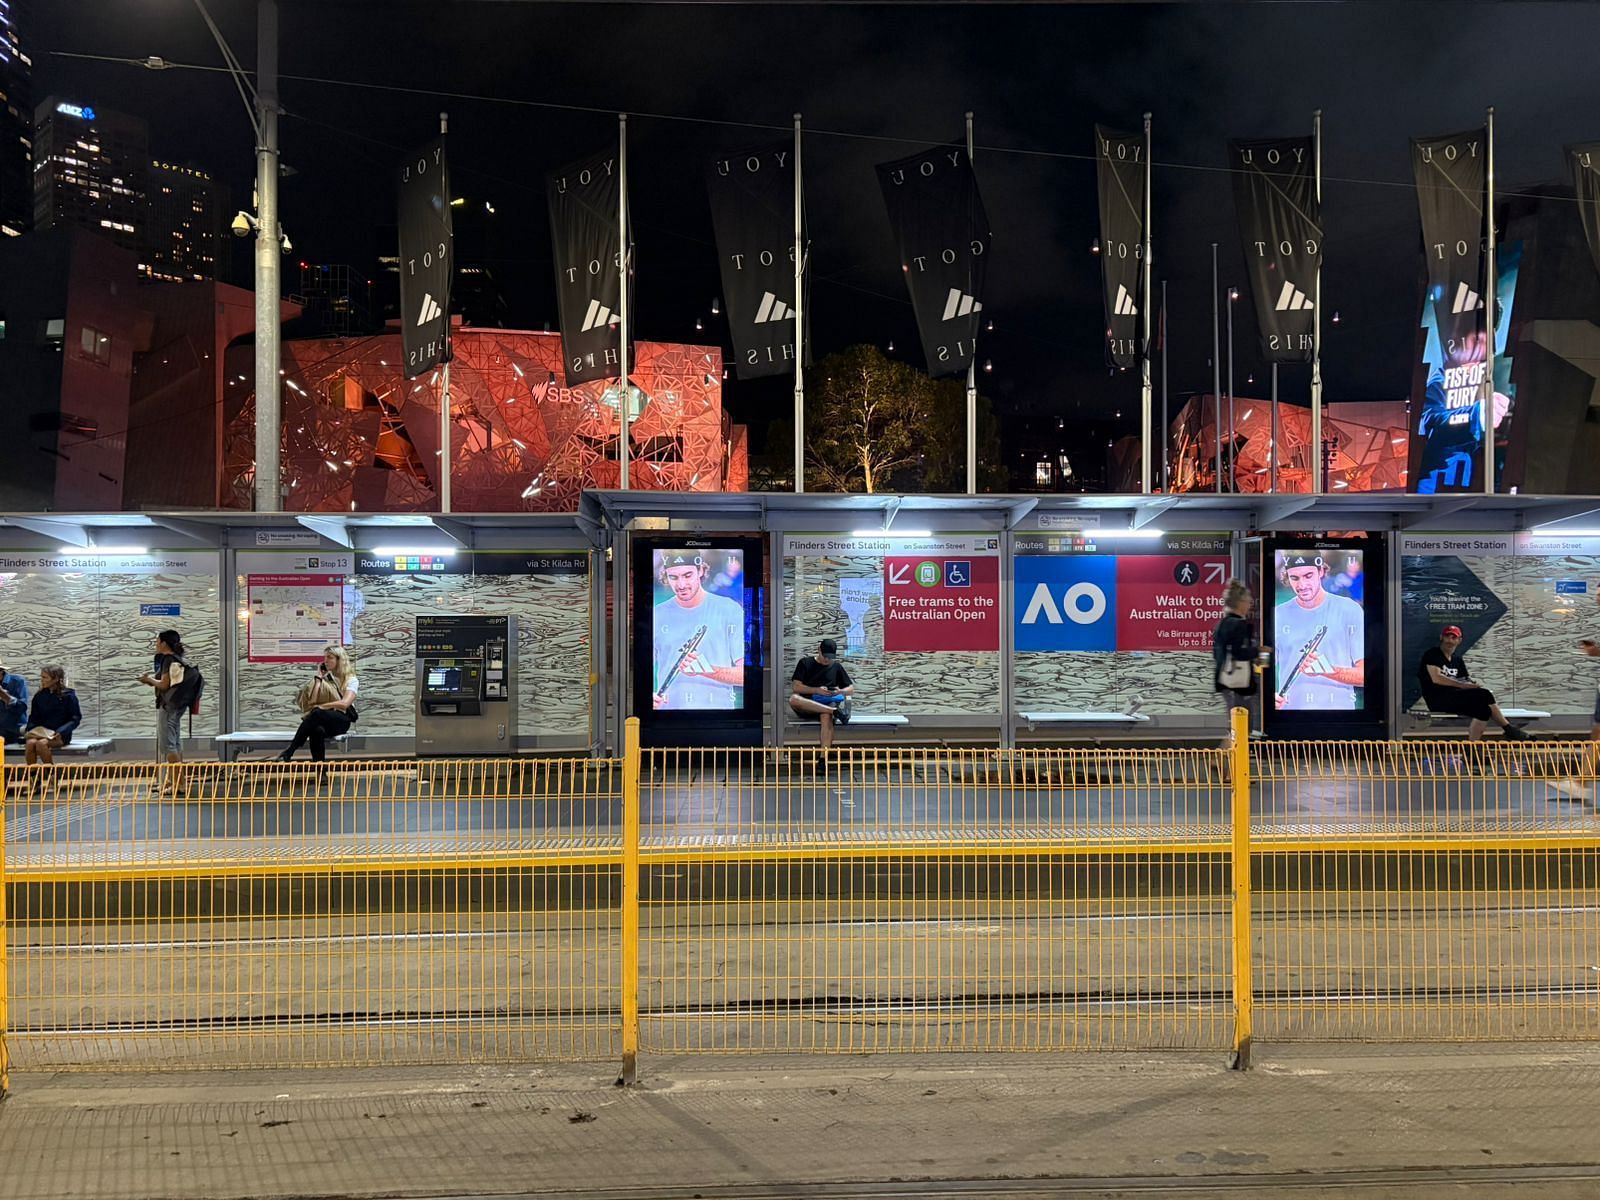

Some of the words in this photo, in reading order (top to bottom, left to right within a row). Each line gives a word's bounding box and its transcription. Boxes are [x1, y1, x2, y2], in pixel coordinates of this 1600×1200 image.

[152, 160, 210, 180] SOFITEL
[1443, 366, 1470, 389] FIST
[1468, 362, 1487, 385] OF
[547, 387, 584, 404] SBS
[1446, 385, 1479, 409] FURY
[789, 541, 825, 550] Flinders
[827, 541, 855, 550] Street
[858, 541, 890, 550] Station
[1015, 541, 1043, 549] Routes
[1167, 541, 1179, 549] via
[1180, 541, 1190, 549] St
[1192, 541, 1212, 549] Kilda
[1214, 541, 1224, 549] Rd
[1404, 540, 1441, 549] Flinders
[1443, 540, 1471, 549] Street
[1474, 540, 1507, 549] Station
[0, 558, 36, 567] Flinders
[38, 558, 68, 567] Street
[71, 558, 107, 567] Station
[320, 560, 336, 568] Stop
[337, 558, 348, 567] 13
[360, 559, 390, 568] Routes
[526, 559, 538, 568] via
[540, 559, 550, 568] St
[552, 559, 572, 568] Kilda
[574, 559, 585, 568] Rd
[662, 557, 735, 566] YOU
[1283, 557, 1356, 566] YOU
[889, 596, 916, 607] Free
[919, 597, 954, 607] trams
[958, 597, 970, 607] to
[974, 596, 994, 607] the
[1021, 582, 1106, 624] AO
[1155, 595, 1186, 606] Walk
[1190, 596, 1203, 606] to
[1205, 595, 1225, 606] the
[1448, 595, 1469, 603] leaving
[889, 609, 951, 620] Australian
[953, 609, 986, 622] Open
[1130, 608, 1191, 619] Australian
[1194, 608, 1226, 621] Open
[417, 617, 434, 625] myki
[1157, 630, 1170, 638] Via
[1170, 630, 1208, 640] Birrarung
[1178, 639, 1189, 647] Up
